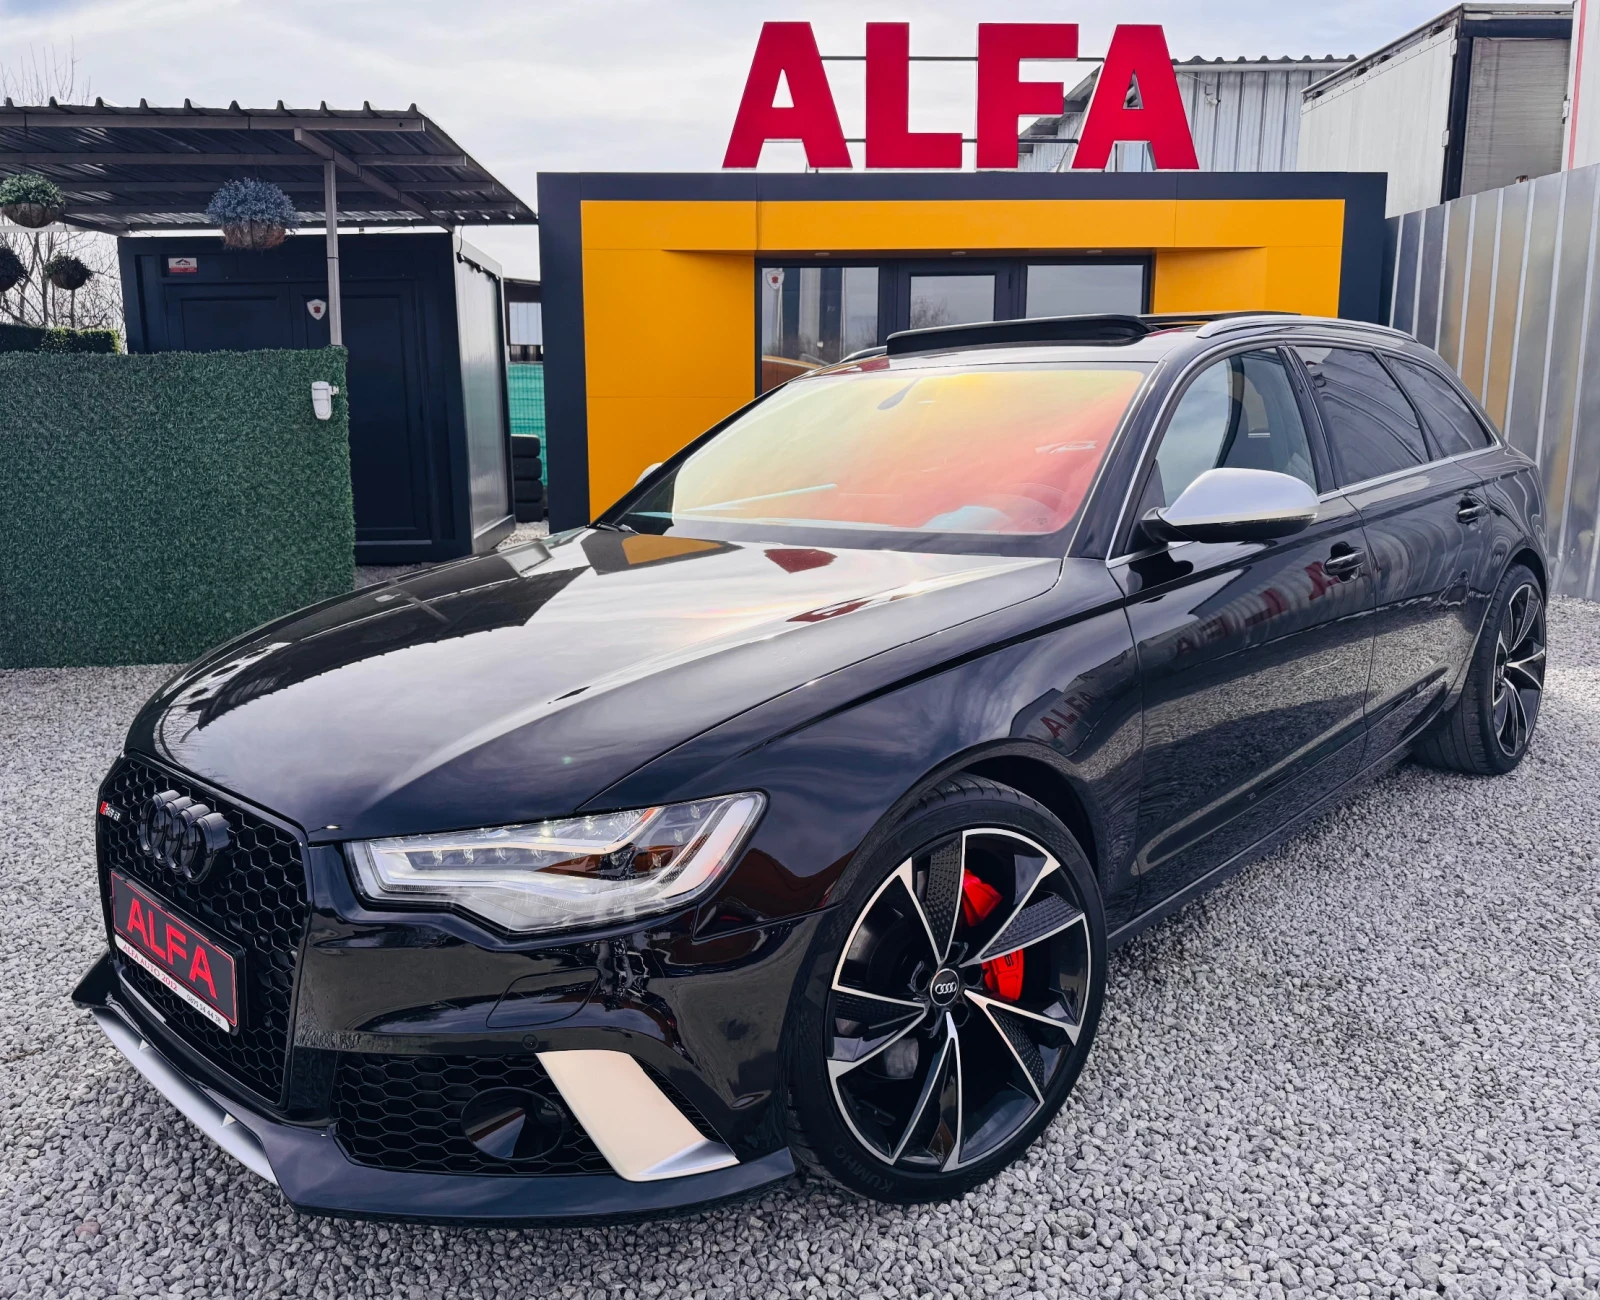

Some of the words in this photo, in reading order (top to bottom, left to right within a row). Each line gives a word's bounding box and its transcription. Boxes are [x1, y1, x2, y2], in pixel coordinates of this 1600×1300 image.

[721, 21, 1200, 170] ALFA
[122, 943, 140, 961] ALFA
[140, 956, 161, 976] AUTO
[161, 974, 178, 992] 2012
[126, 897, 218, 1000] ALFA
[834, 1144, 895, 1193] KUMHO
